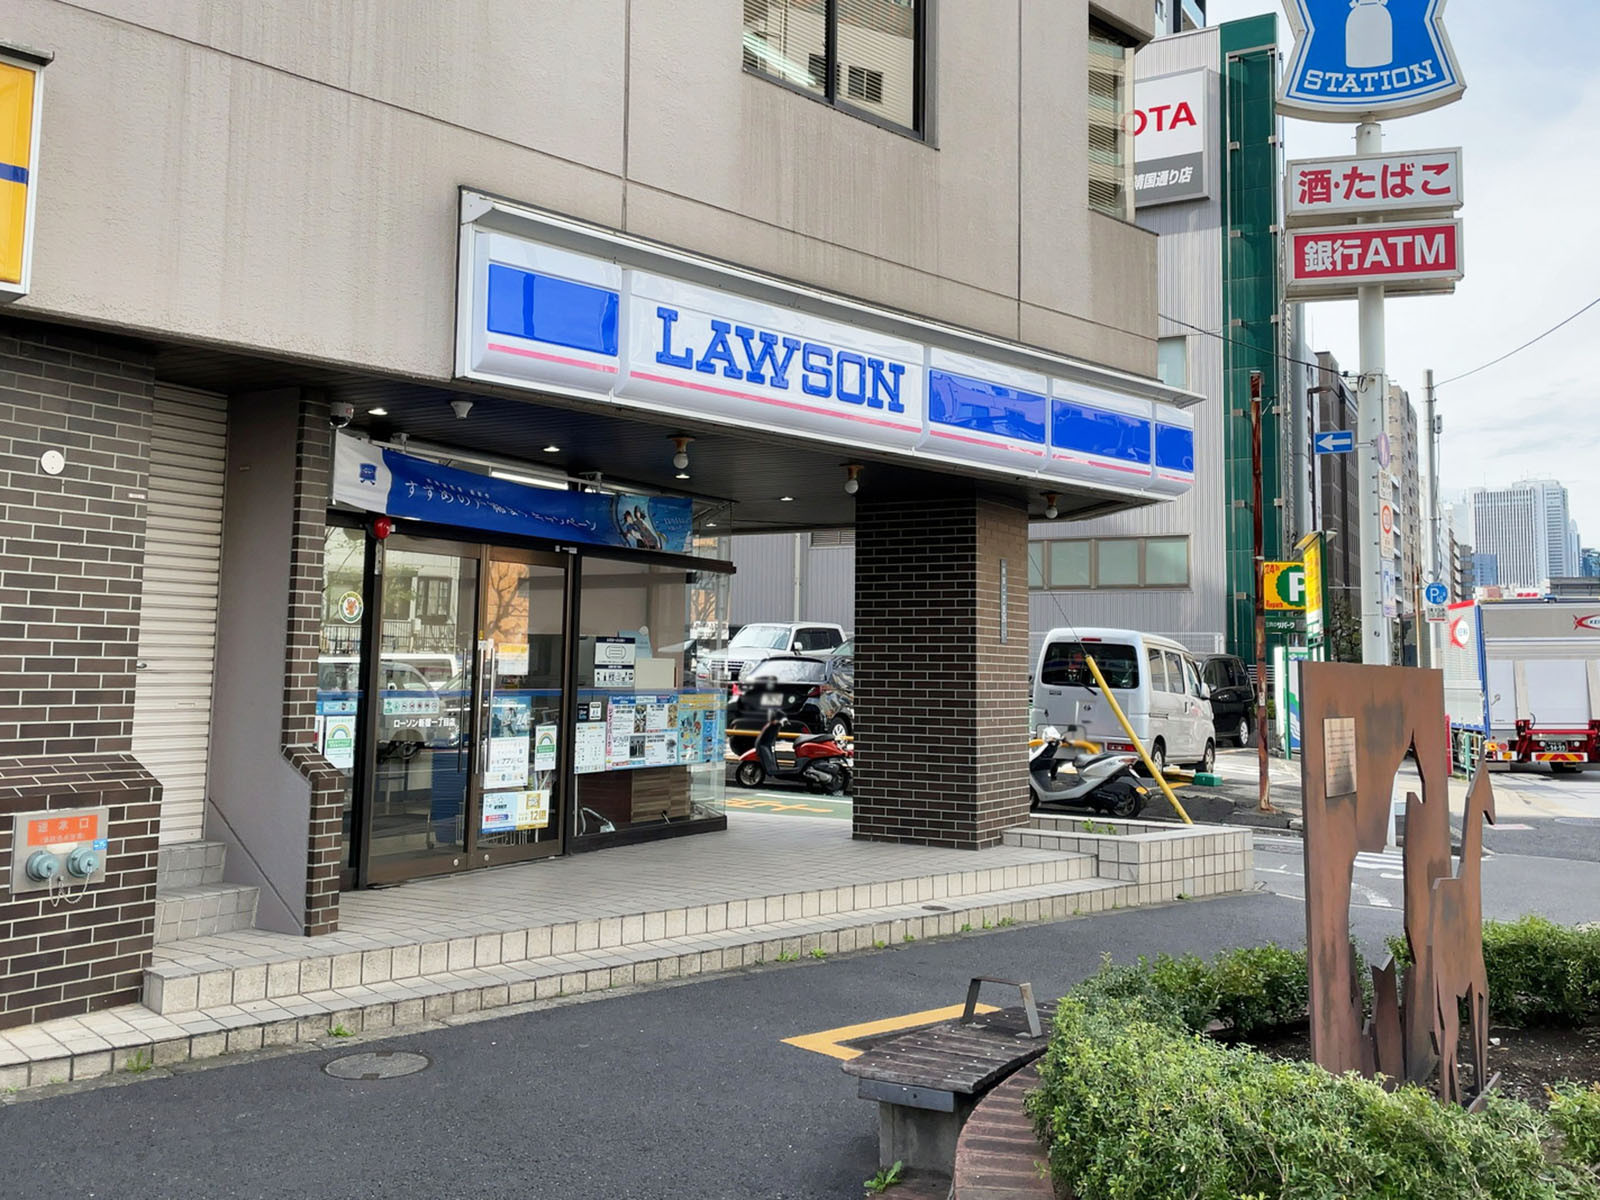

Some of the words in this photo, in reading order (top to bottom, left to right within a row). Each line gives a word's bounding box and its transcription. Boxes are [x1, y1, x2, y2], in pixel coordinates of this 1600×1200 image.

[1303, 59, 1436, 93] STATION
[1304, 233, 1446, 272] 銀行ATM
[655, 306, 906, 414] LAWSON
[1289, 572, 1305, 602] P
